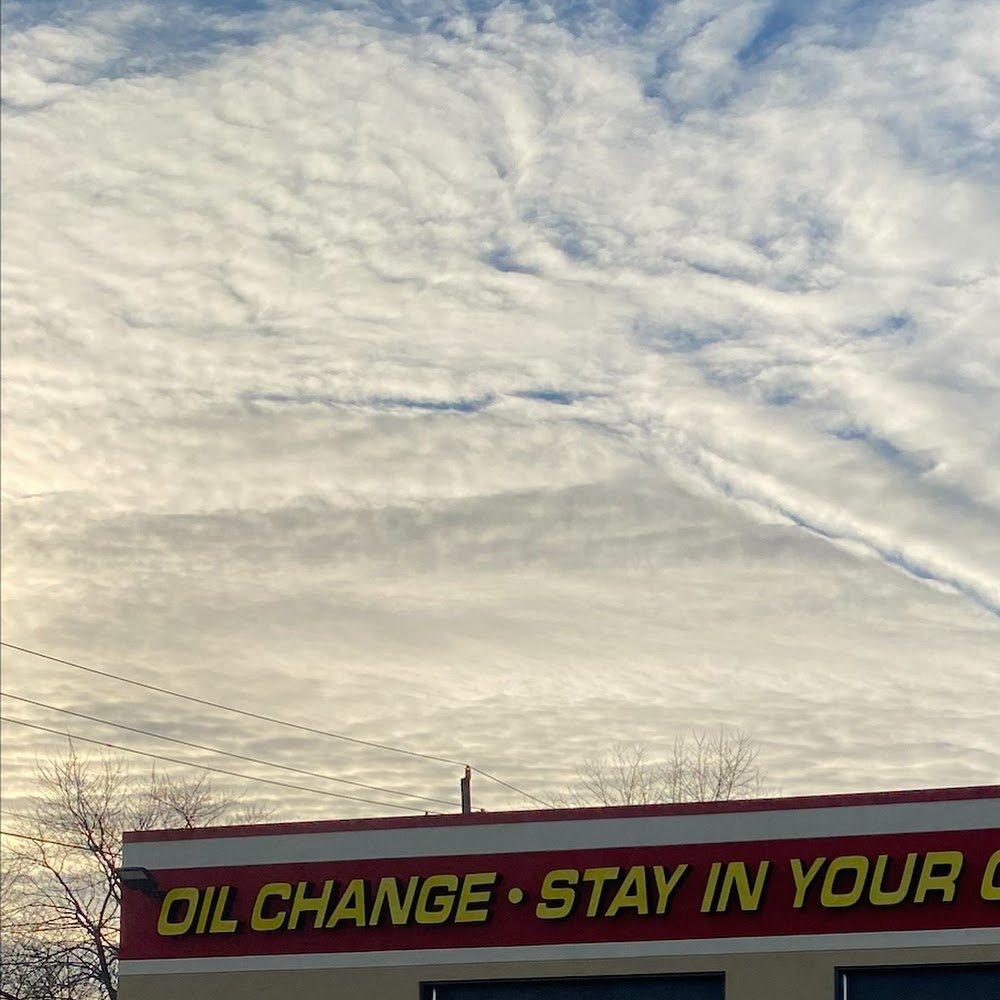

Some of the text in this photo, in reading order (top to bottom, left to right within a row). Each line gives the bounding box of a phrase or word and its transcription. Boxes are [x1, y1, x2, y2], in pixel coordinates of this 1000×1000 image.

[156, 885, 238, 937] OIL
[250, 871, 497, 932] CHANGE
[535, 863, 689, 920] STAY
[700, 860, 770, 913] IN
[789, 850, 964, 909] YOUR
